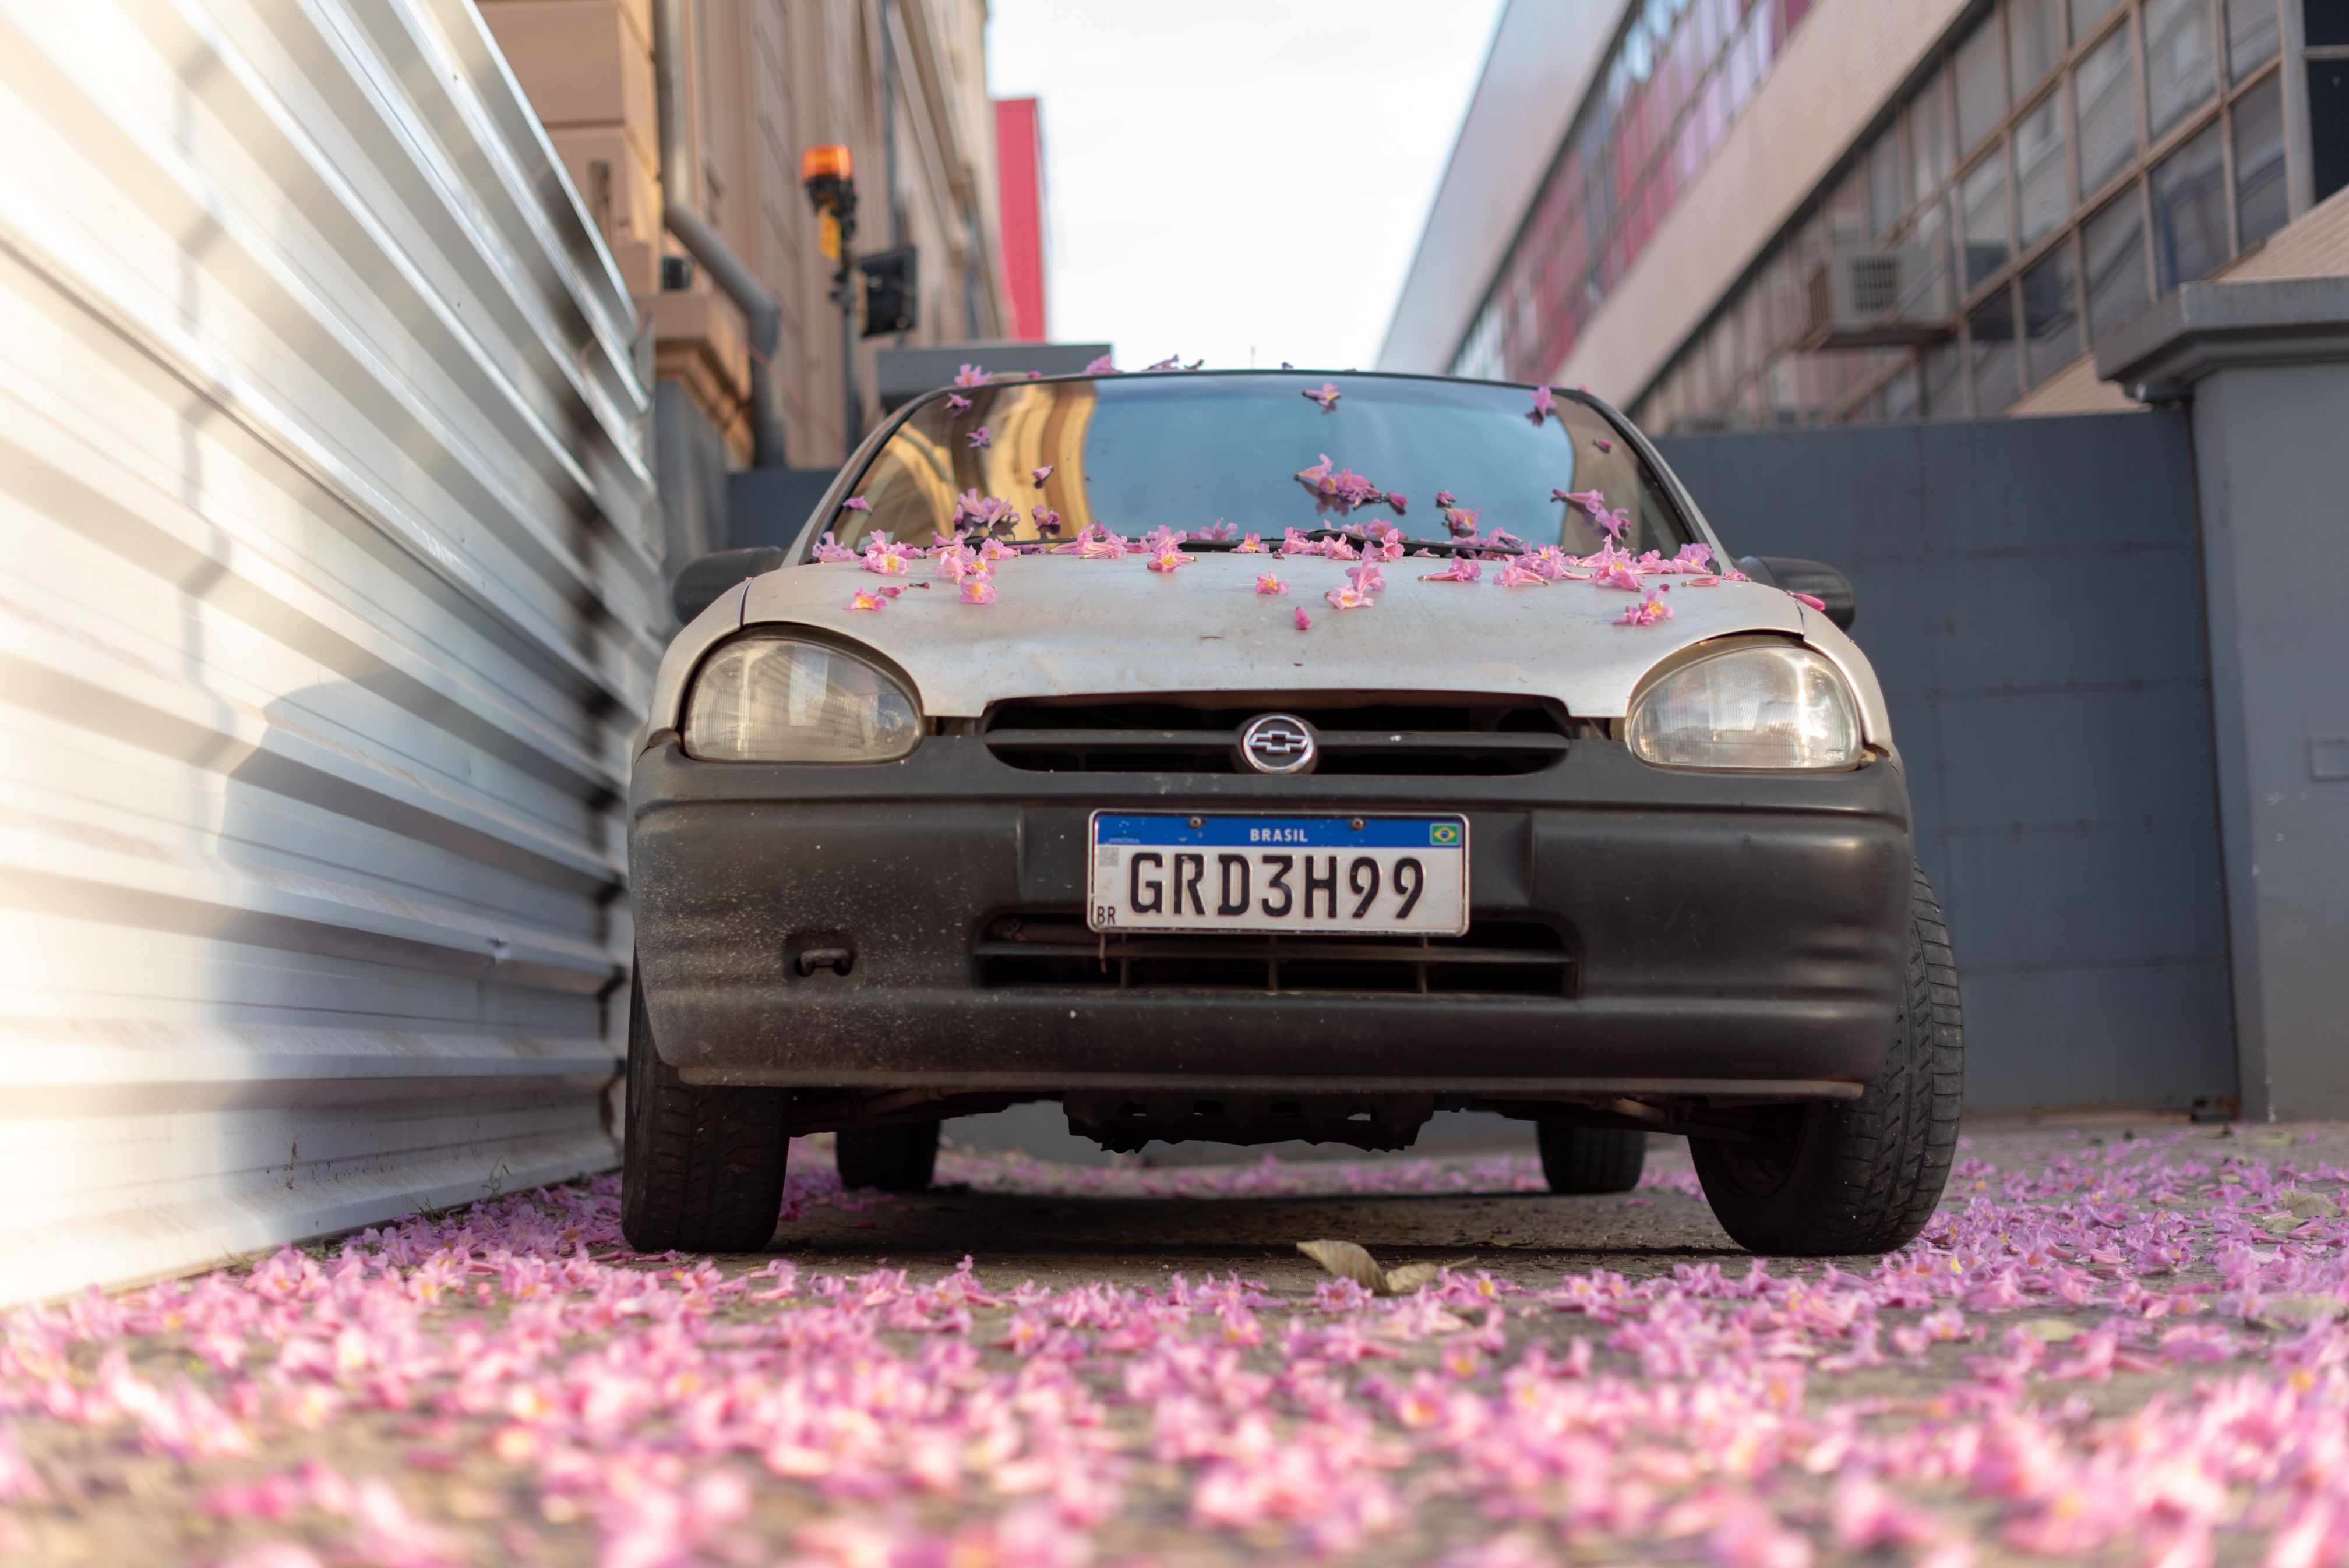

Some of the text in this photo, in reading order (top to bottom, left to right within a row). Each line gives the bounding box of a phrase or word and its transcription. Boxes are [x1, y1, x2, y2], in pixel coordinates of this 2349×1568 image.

[1250, 828, 1308, 842] BRASIL
[1130, 852, 1424, 919] GRD3H99
[1098, 906, 1115, 924] BR
